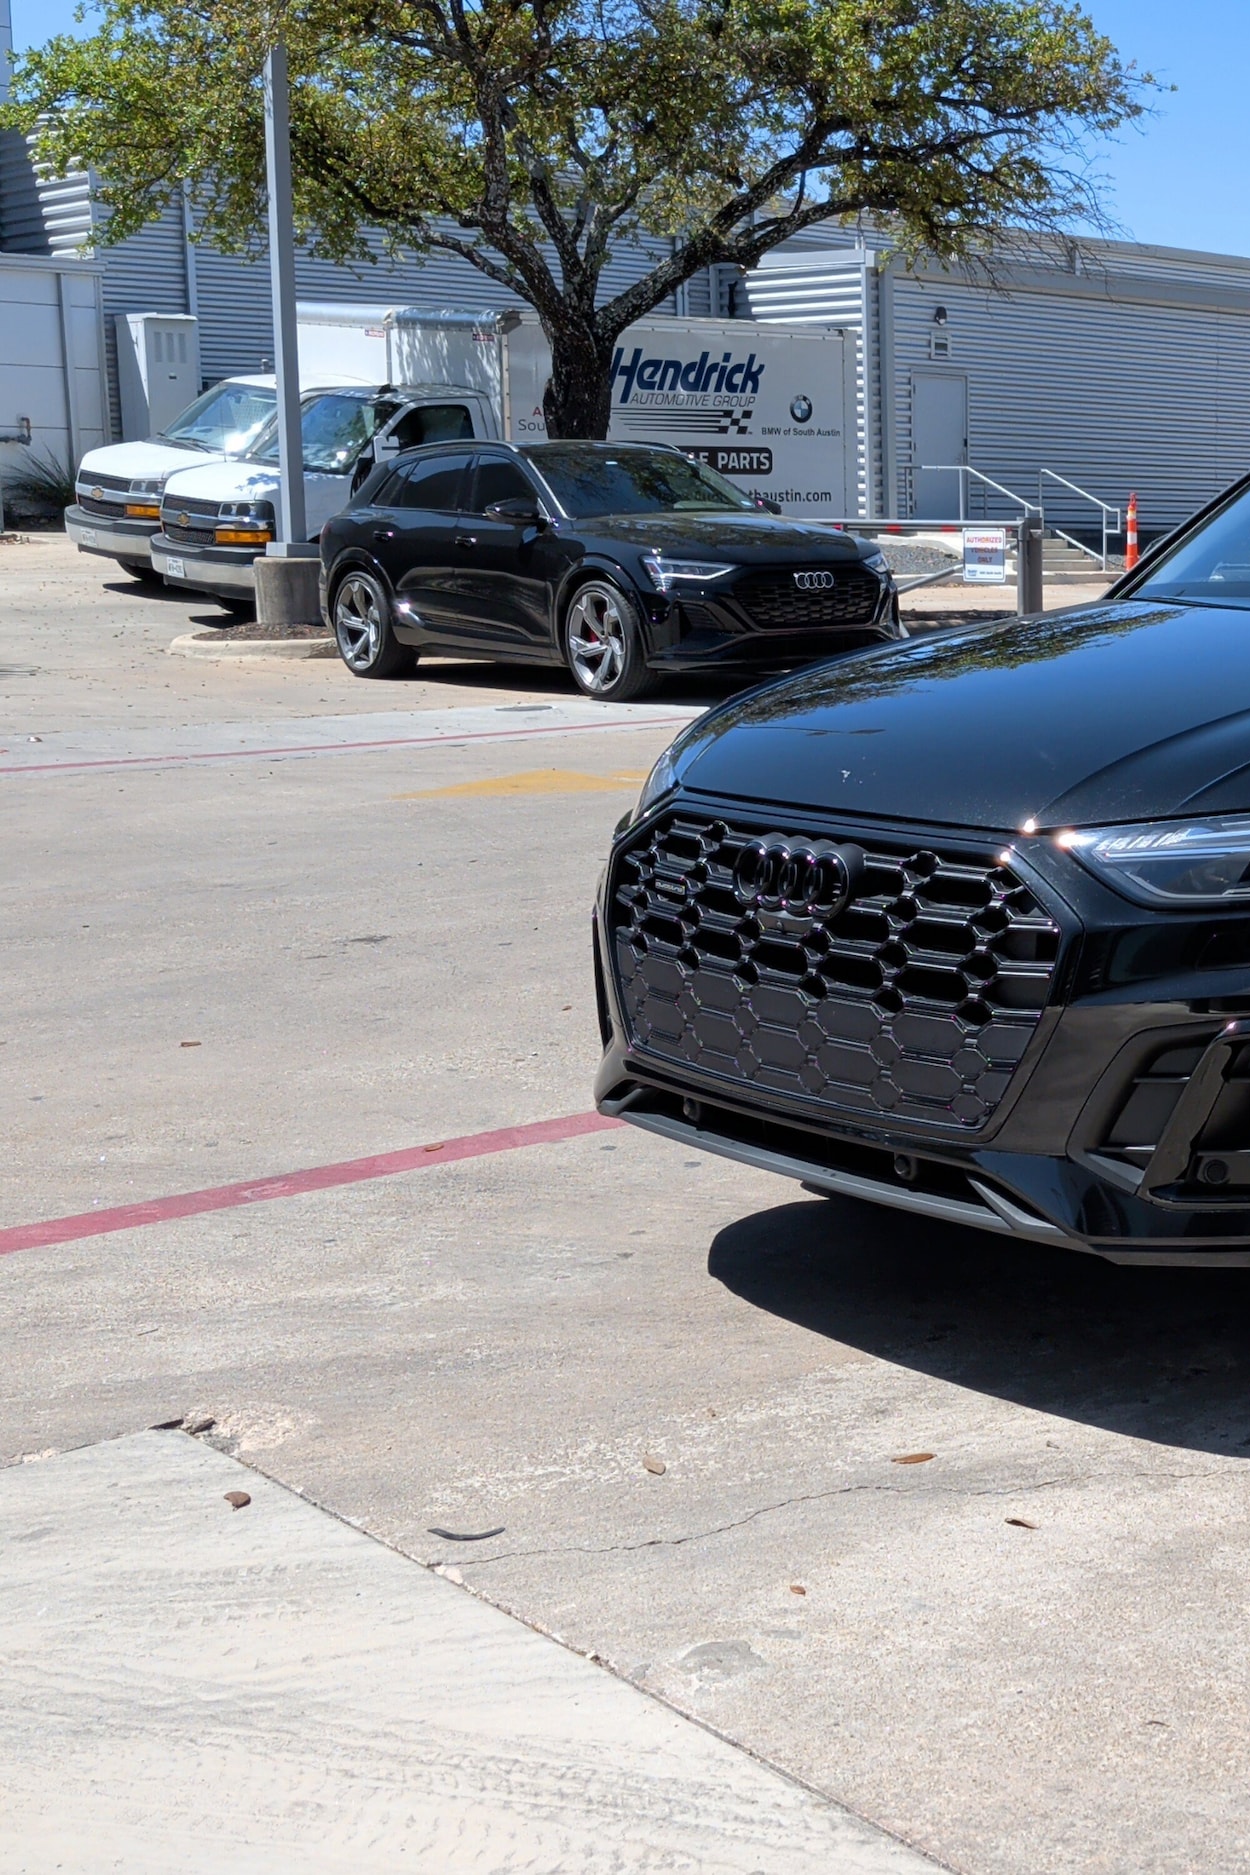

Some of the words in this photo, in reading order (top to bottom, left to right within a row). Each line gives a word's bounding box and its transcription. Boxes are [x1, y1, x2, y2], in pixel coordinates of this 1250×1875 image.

[611, 347, 765, 404] Hendrick
[630, 392, 710, 406] AUTOMOTIVE
[713, 395, 756, 407] GROUP
[518, 420, 548, 434] Sou
[761, 427, 782, 436] BMW
[784, 428, 791, 436] of
[792, 428, 816, 436] South
[817, 428, 841, 437] Austin
[717, 452, 770, 470] PARTS
